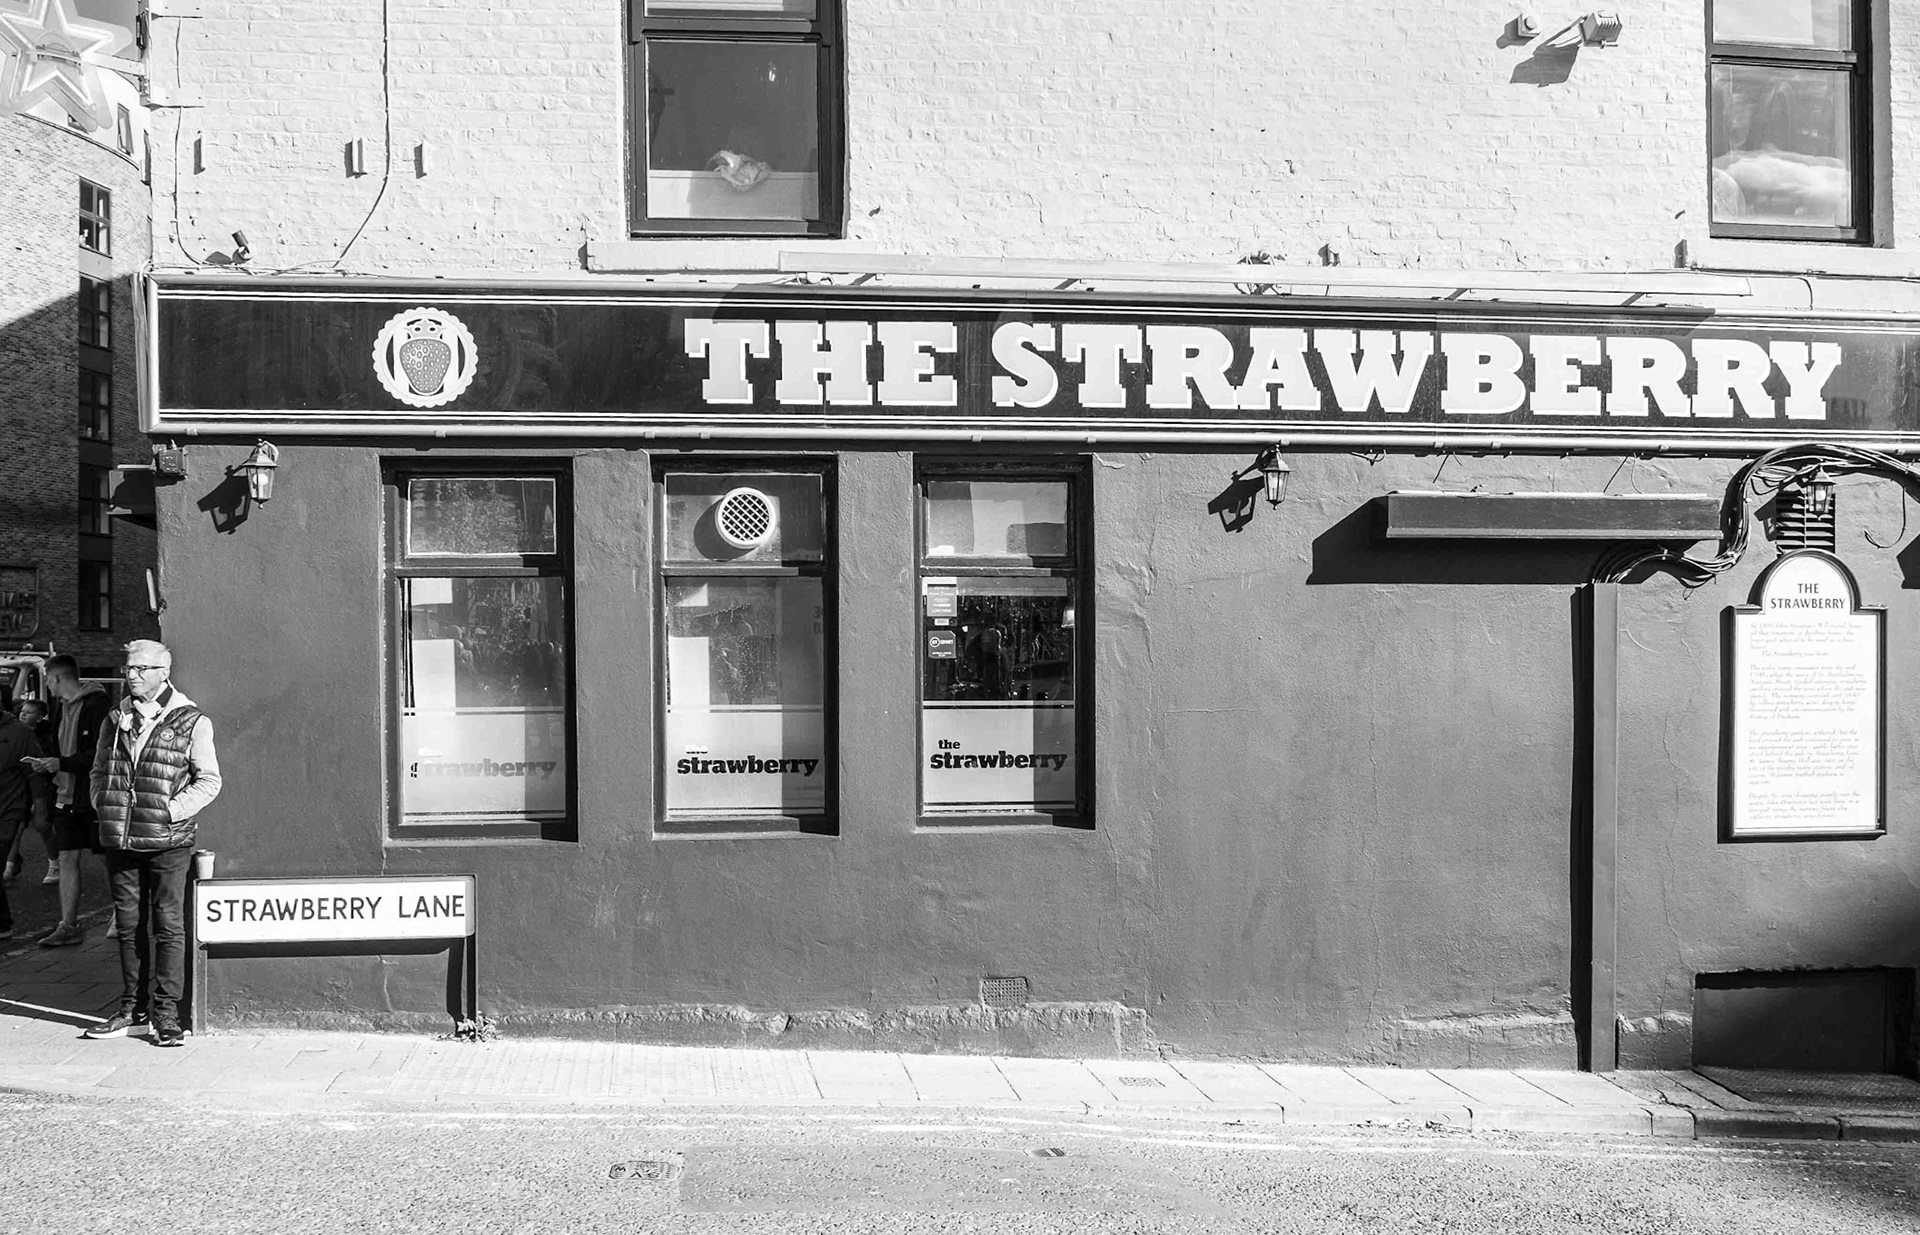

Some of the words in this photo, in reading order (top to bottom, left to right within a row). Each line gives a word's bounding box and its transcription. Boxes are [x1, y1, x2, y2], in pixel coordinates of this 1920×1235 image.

[684, 318, 957, 406] THE
[991, 321, 1841, 420] STRAWBERRY
[1797, 583, 1820, 594] THE
[1770, 597, 1846, 609] STRAWBERRY
[938, 739, 961, 750] the
[677, 755, 819, 777] strawberry
[930, 750, 1067, 772] strawberry
[206, 895, 382, 922] STRAWBERRY
[398, 895, 465, 918] LANE
